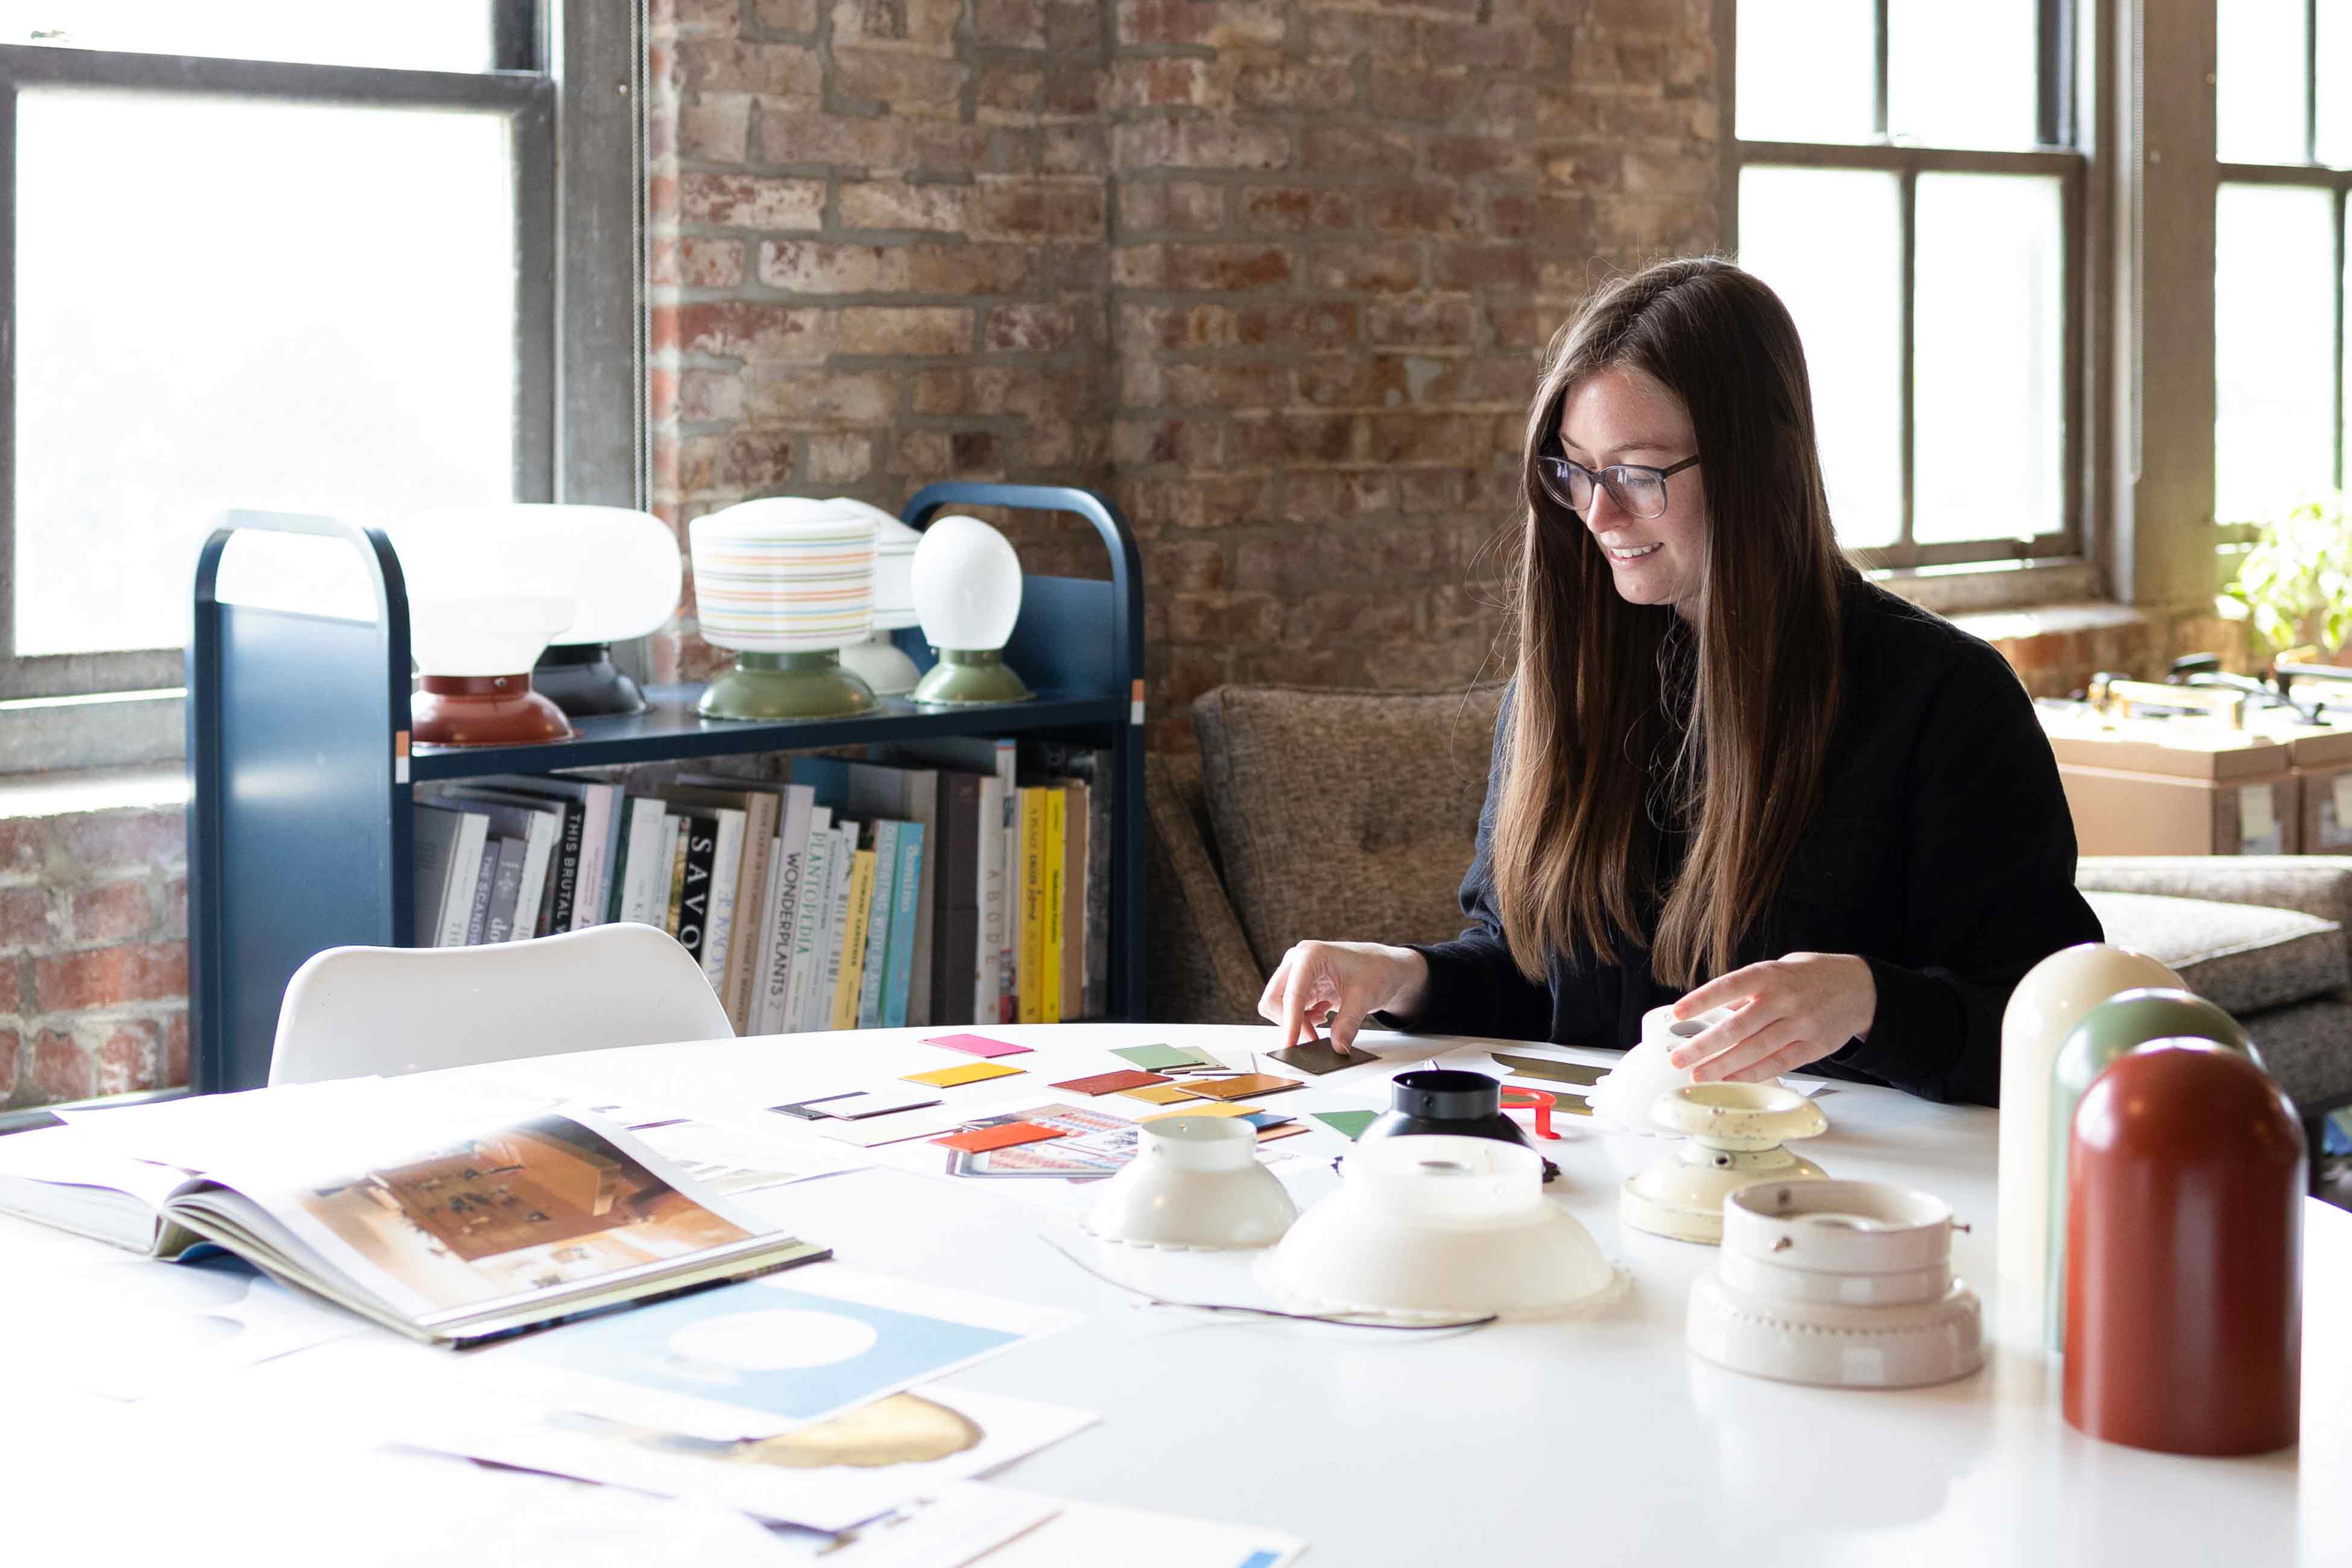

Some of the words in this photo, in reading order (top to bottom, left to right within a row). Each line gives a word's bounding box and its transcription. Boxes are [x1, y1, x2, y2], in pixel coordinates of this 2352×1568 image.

[565, 814, 581, 853] THIS
[557, 857, 576, 920] BRUTAL
[680, 836, 713, 949] SAVO
[771, 851, 800, 996] WONDERPLANTS
[796, 832, 826, 954] PLANTOPEDIA
[985, 869, 999, 965] ABODE
